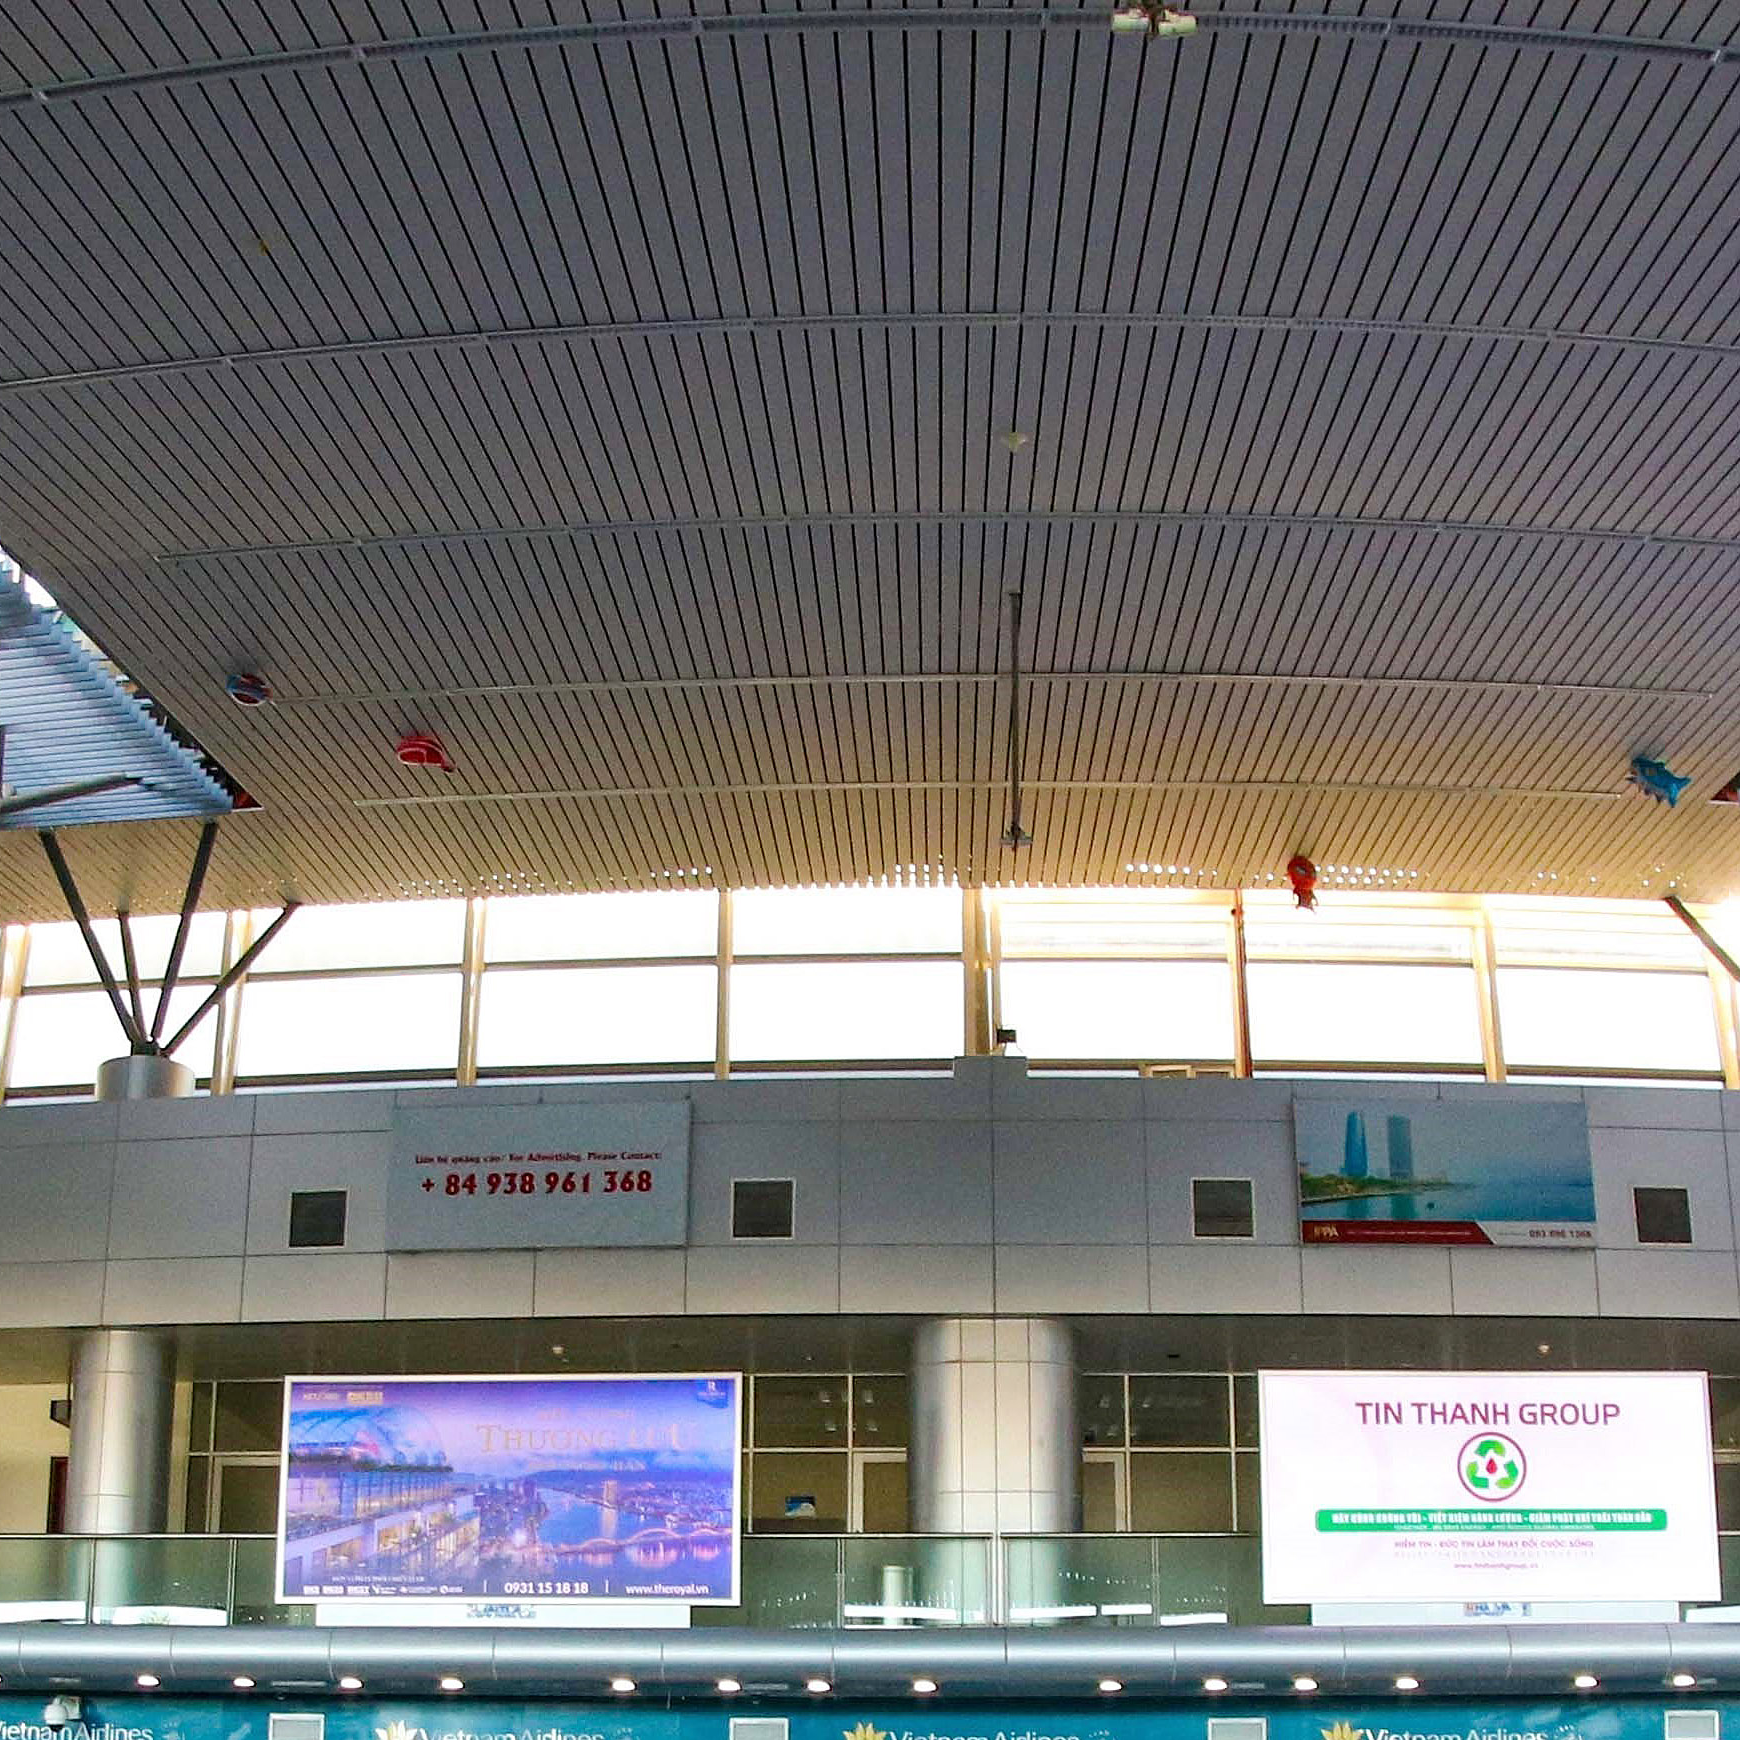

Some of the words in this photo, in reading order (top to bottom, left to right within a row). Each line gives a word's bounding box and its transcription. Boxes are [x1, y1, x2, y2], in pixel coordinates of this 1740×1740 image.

[445, 1174, 477, 1196] 84
[486, 1172, 535, 1195] 938
[545, 1172, 590, 1194] 961
[603, 1170, 652, 1193] 368
[1355, 1402, 1402, 1426] TIN
[1411, 1403, 1510, 1426] THANH
[1518, 1402, 1621, 1426] GROUP
[505, 1582, 534, 1596] 0931
[537, 1582, 552, 1596] 15
[557, 1582, 571, 1596] 18
[575, 1582, 589, 1596] 18
